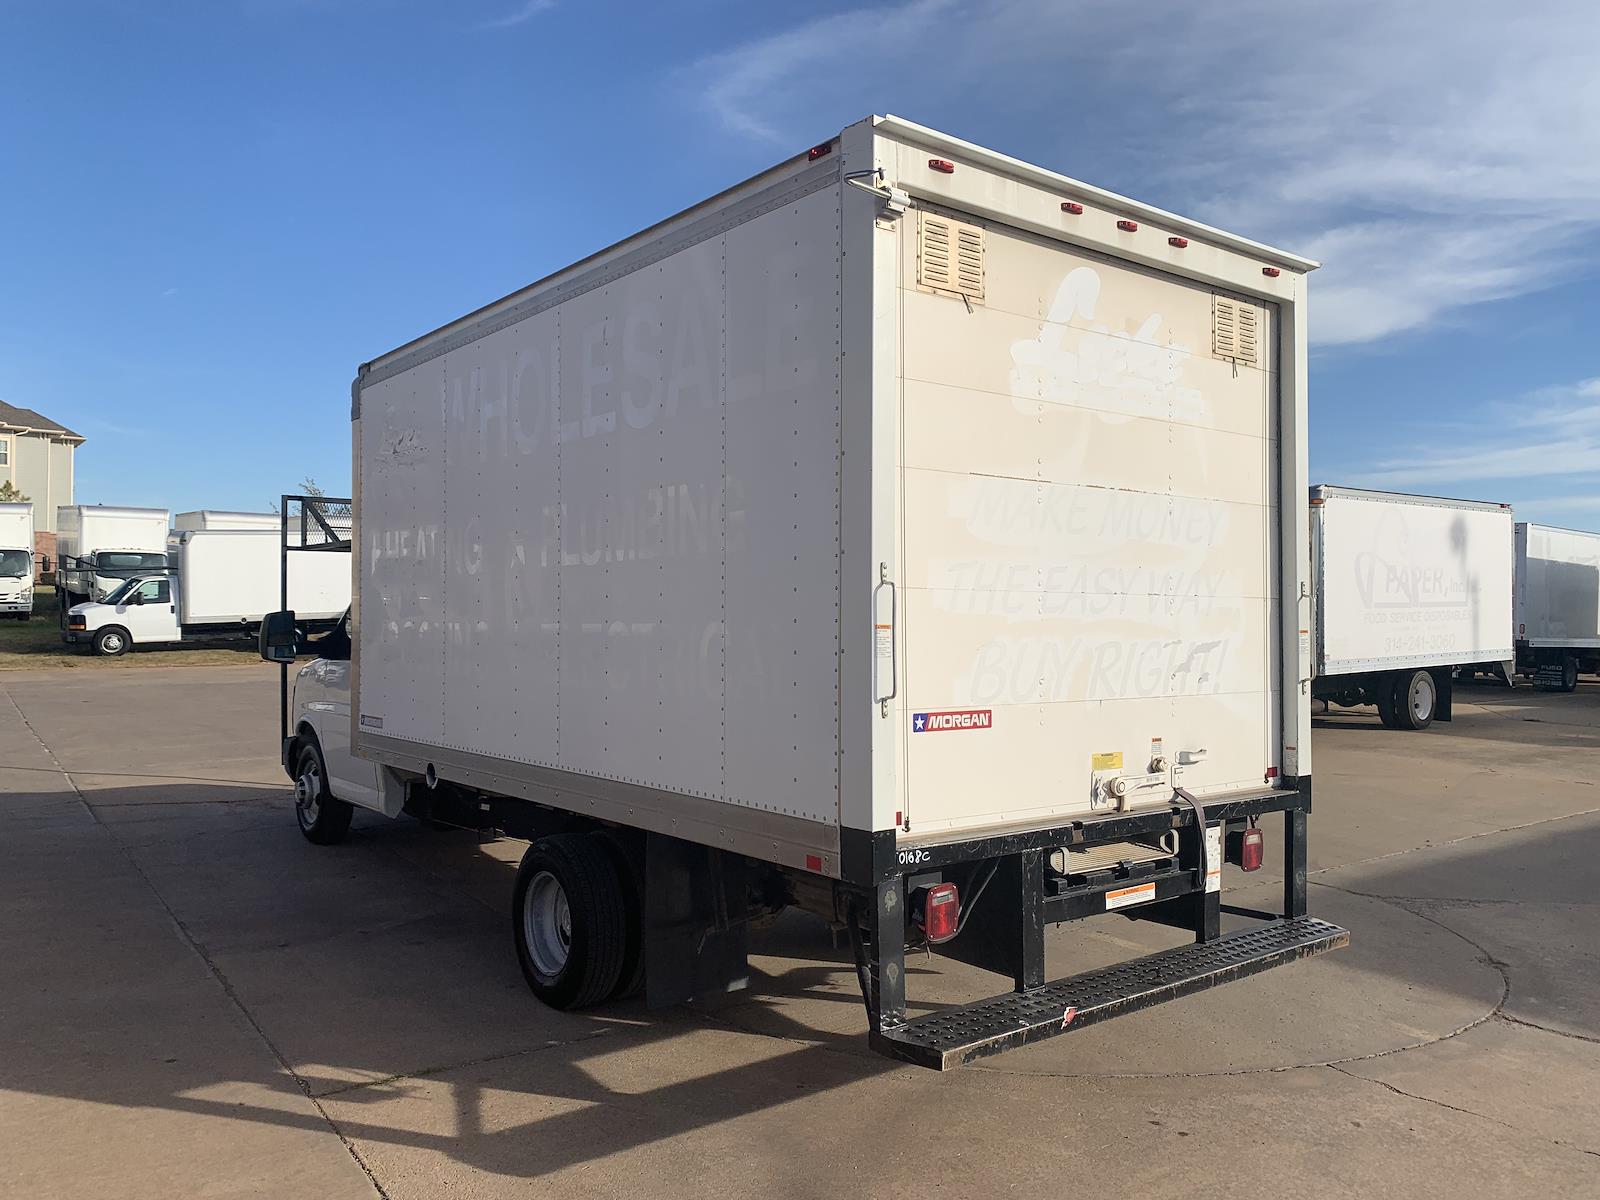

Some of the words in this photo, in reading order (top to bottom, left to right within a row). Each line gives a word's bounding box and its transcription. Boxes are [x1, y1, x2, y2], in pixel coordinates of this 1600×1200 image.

[437, 246, 817, 466] WHOLESALE
[540, 475, 746, 568] PLUMBING
[968, 482, 1088, 535] MAKE
[1098, 491, 1222, 545] MONEY
[947, 559, 1030, 614] THE
[1041, 564, 1141, 615] EASY
[1148, 567, 1226, 616] WAY
[970, 636, 1084, 703] BUY
[1089, 637, 1231, 698] RIGHT!
[928, 713, 990, 729] MORGAN
